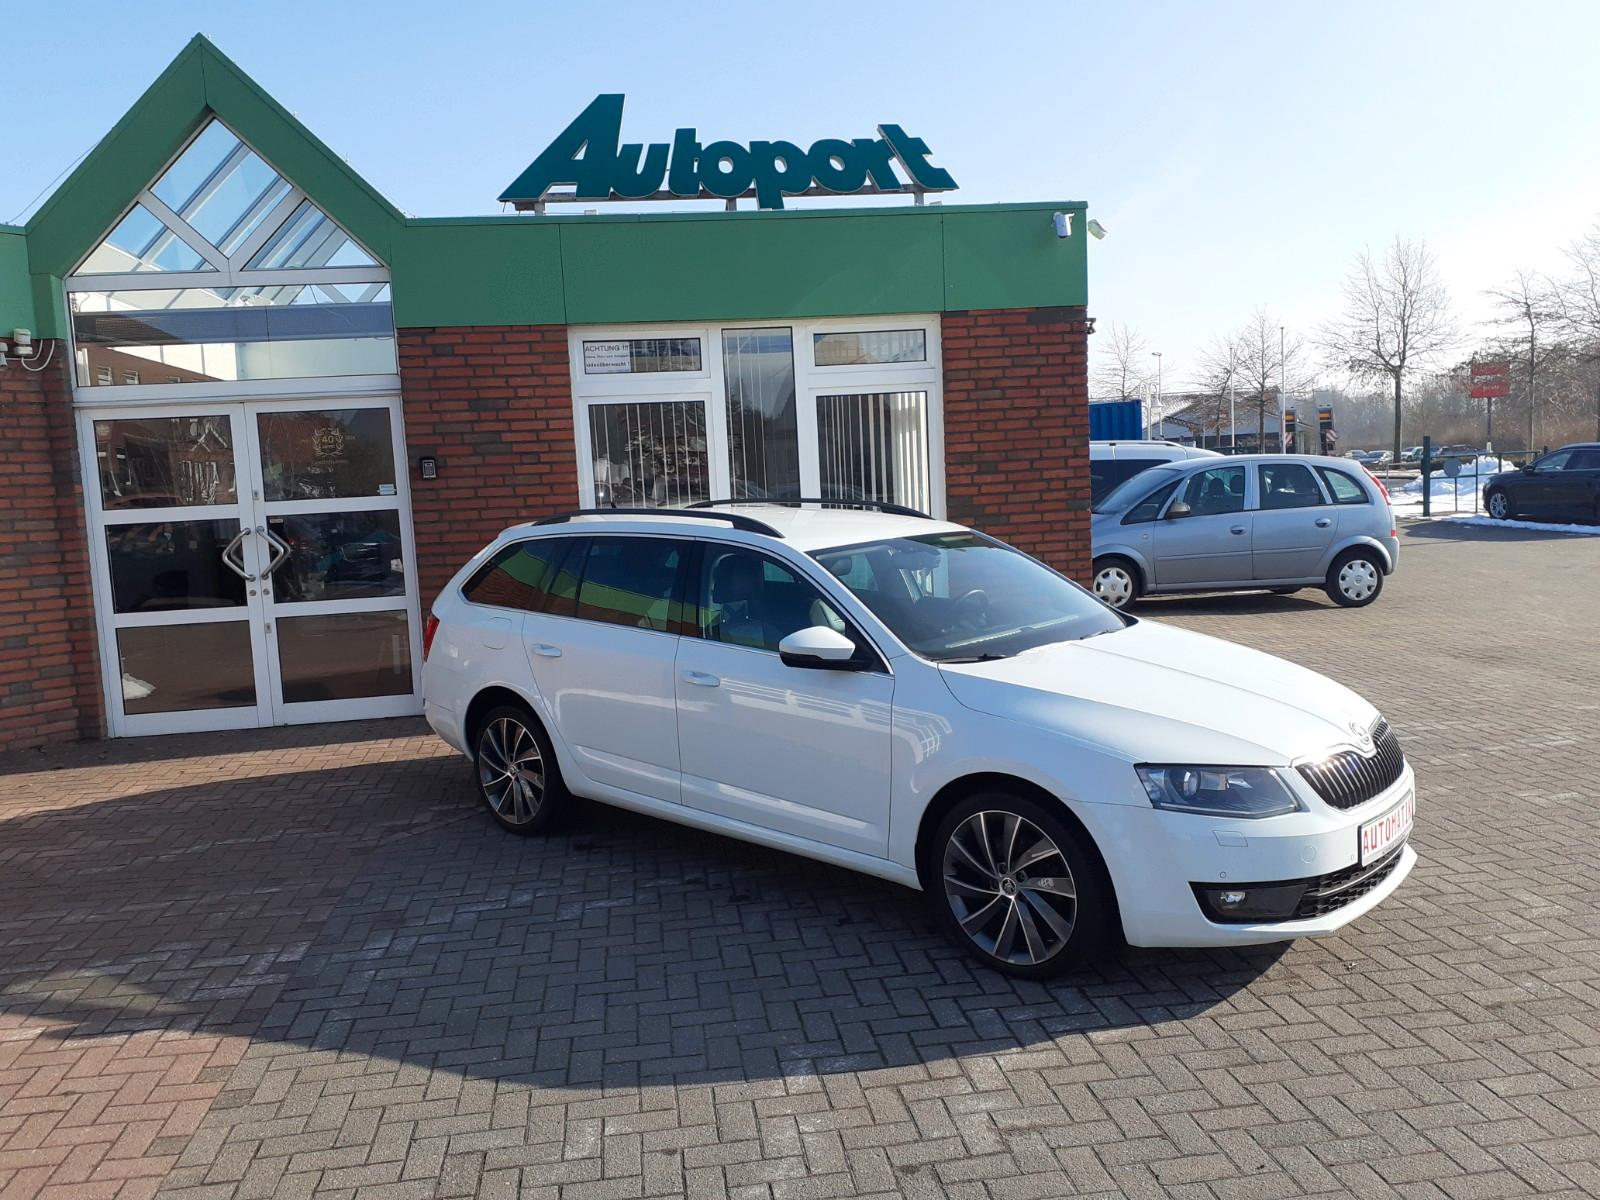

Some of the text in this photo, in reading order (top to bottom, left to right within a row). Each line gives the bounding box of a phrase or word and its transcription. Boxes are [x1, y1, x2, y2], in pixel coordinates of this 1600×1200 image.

[497, 94, 959, 209] Autoport
[585, 344, 620, 352] ACHTUNG
[322, 435, 334, 443] 40
